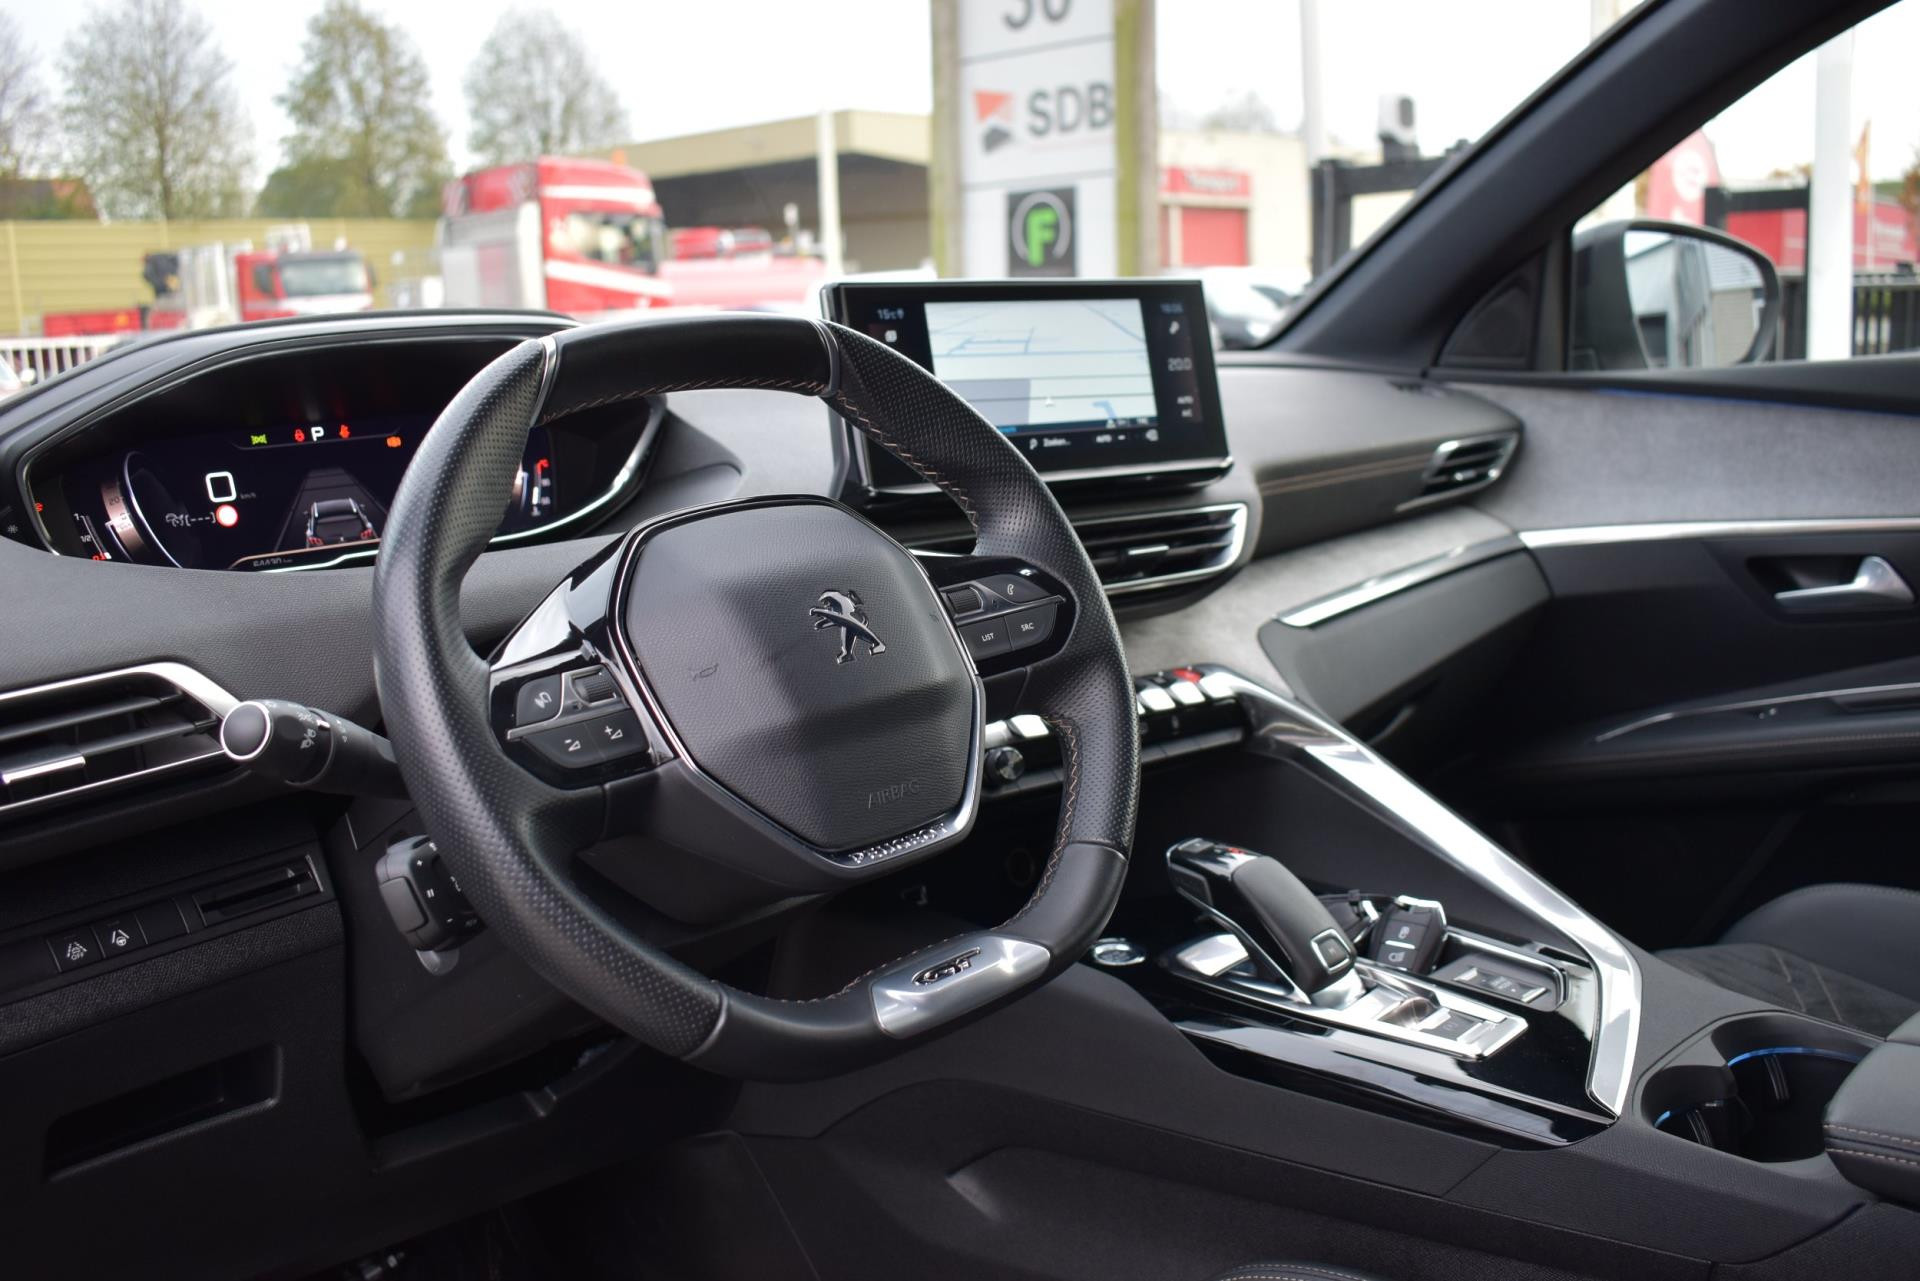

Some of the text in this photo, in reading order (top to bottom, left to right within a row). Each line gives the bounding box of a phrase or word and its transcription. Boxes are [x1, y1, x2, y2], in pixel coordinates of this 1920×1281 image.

[1027, 82, 1113, 138] SDB
[310, 426, 325, 442] P
[205, 471, 238, 503] 0
[1020, 622, 1035, 632] SRC
[981, 632, 995, 642] LIST
